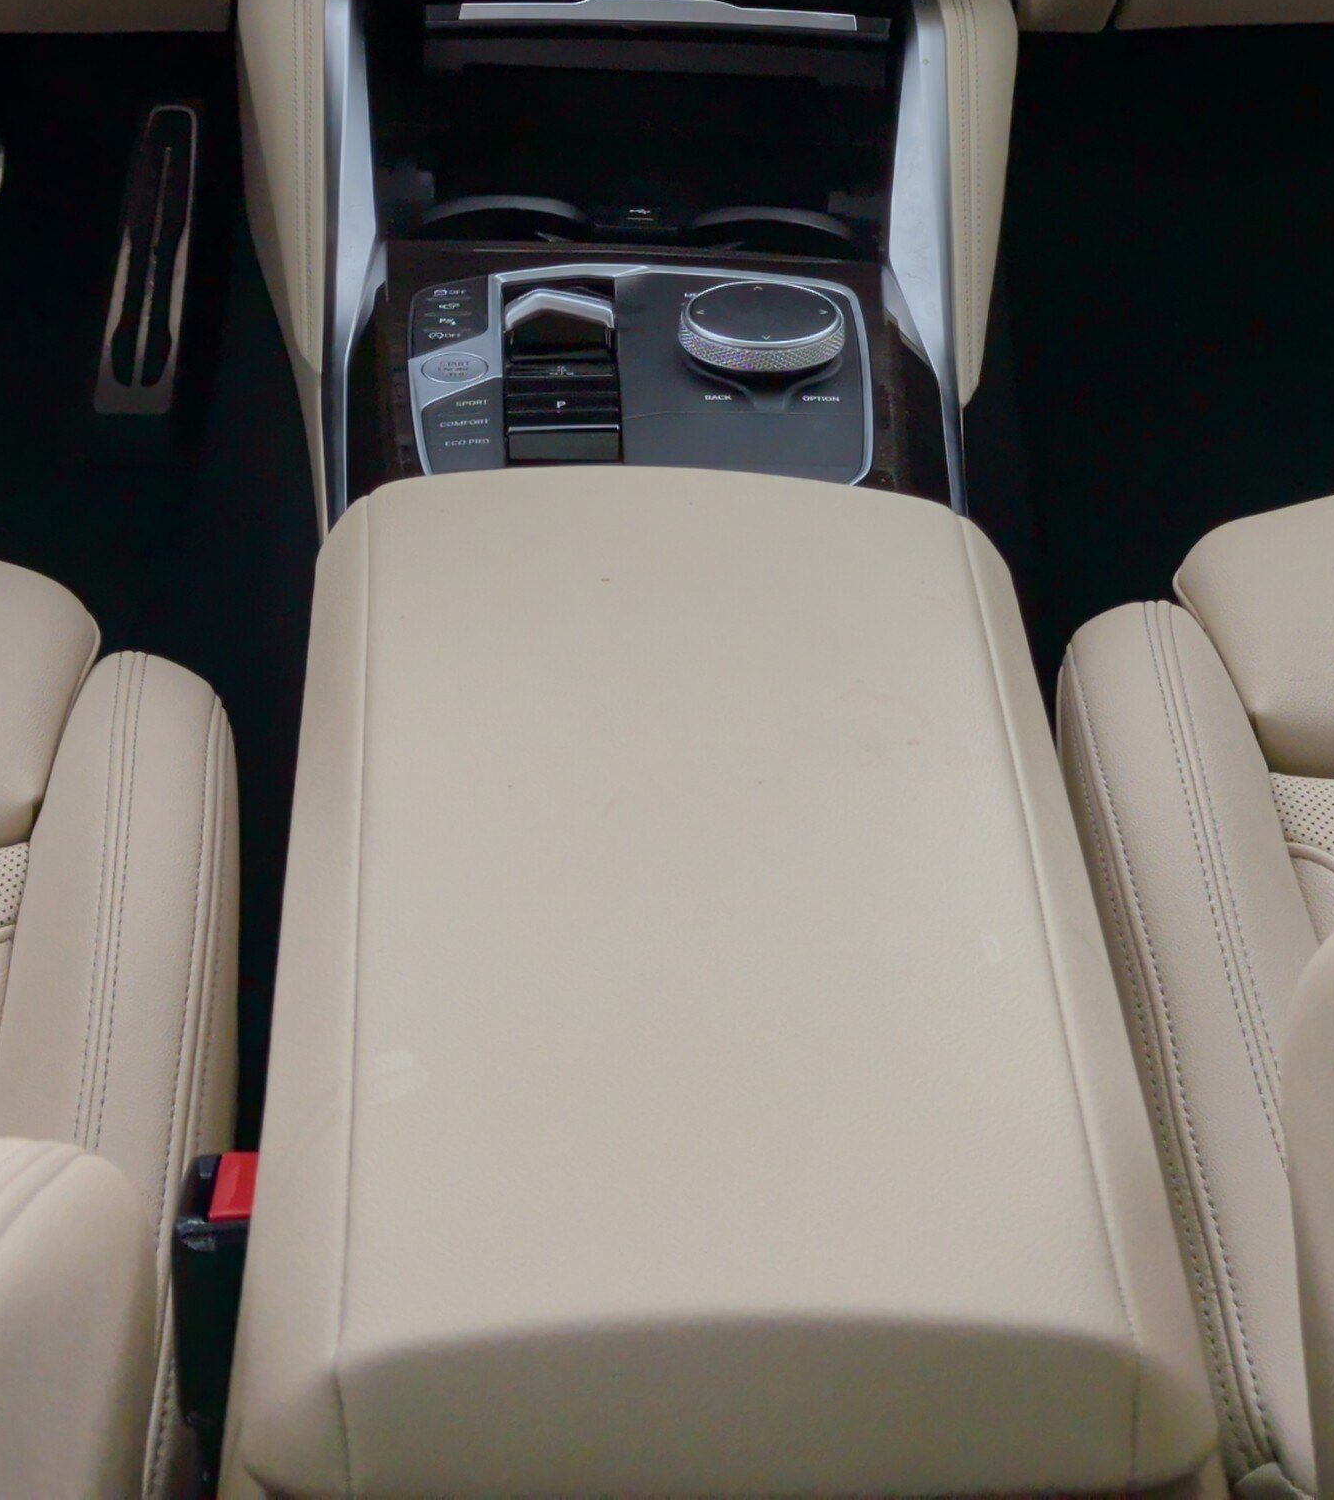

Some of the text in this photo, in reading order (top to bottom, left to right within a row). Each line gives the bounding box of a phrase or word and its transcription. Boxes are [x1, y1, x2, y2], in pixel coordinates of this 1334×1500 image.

[455, 398, 488, 407] SPORT
[802, 395, 840, 403] OPTION
[556, 400, 566, 410] P
[439, 418, 491, 428] COMFORT
[444, 437, 490, 447] ECO PRO
